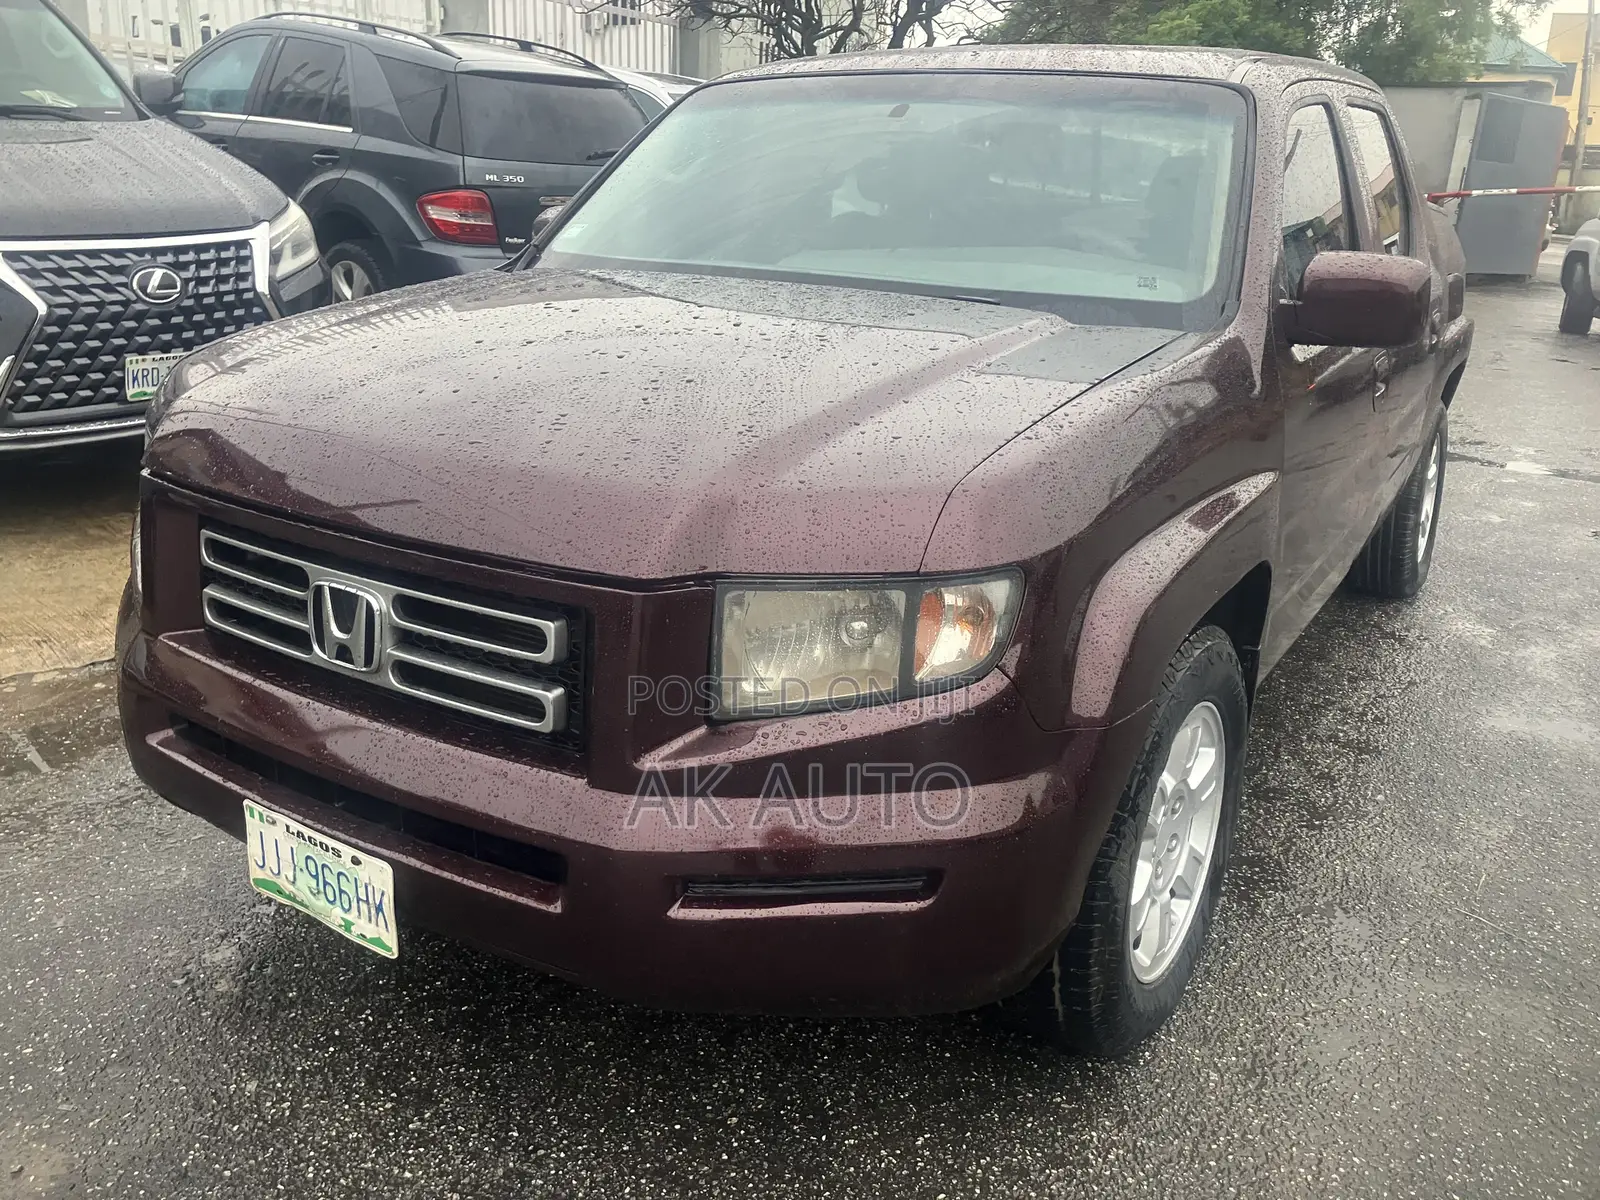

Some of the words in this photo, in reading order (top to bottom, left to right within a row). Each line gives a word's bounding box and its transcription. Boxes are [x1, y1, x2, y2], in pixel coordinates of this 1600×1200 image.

[485, 173, 500, 182] ML
[502, 175, 525, 183] 350
[285, 823, 342, 858] LAGOS
